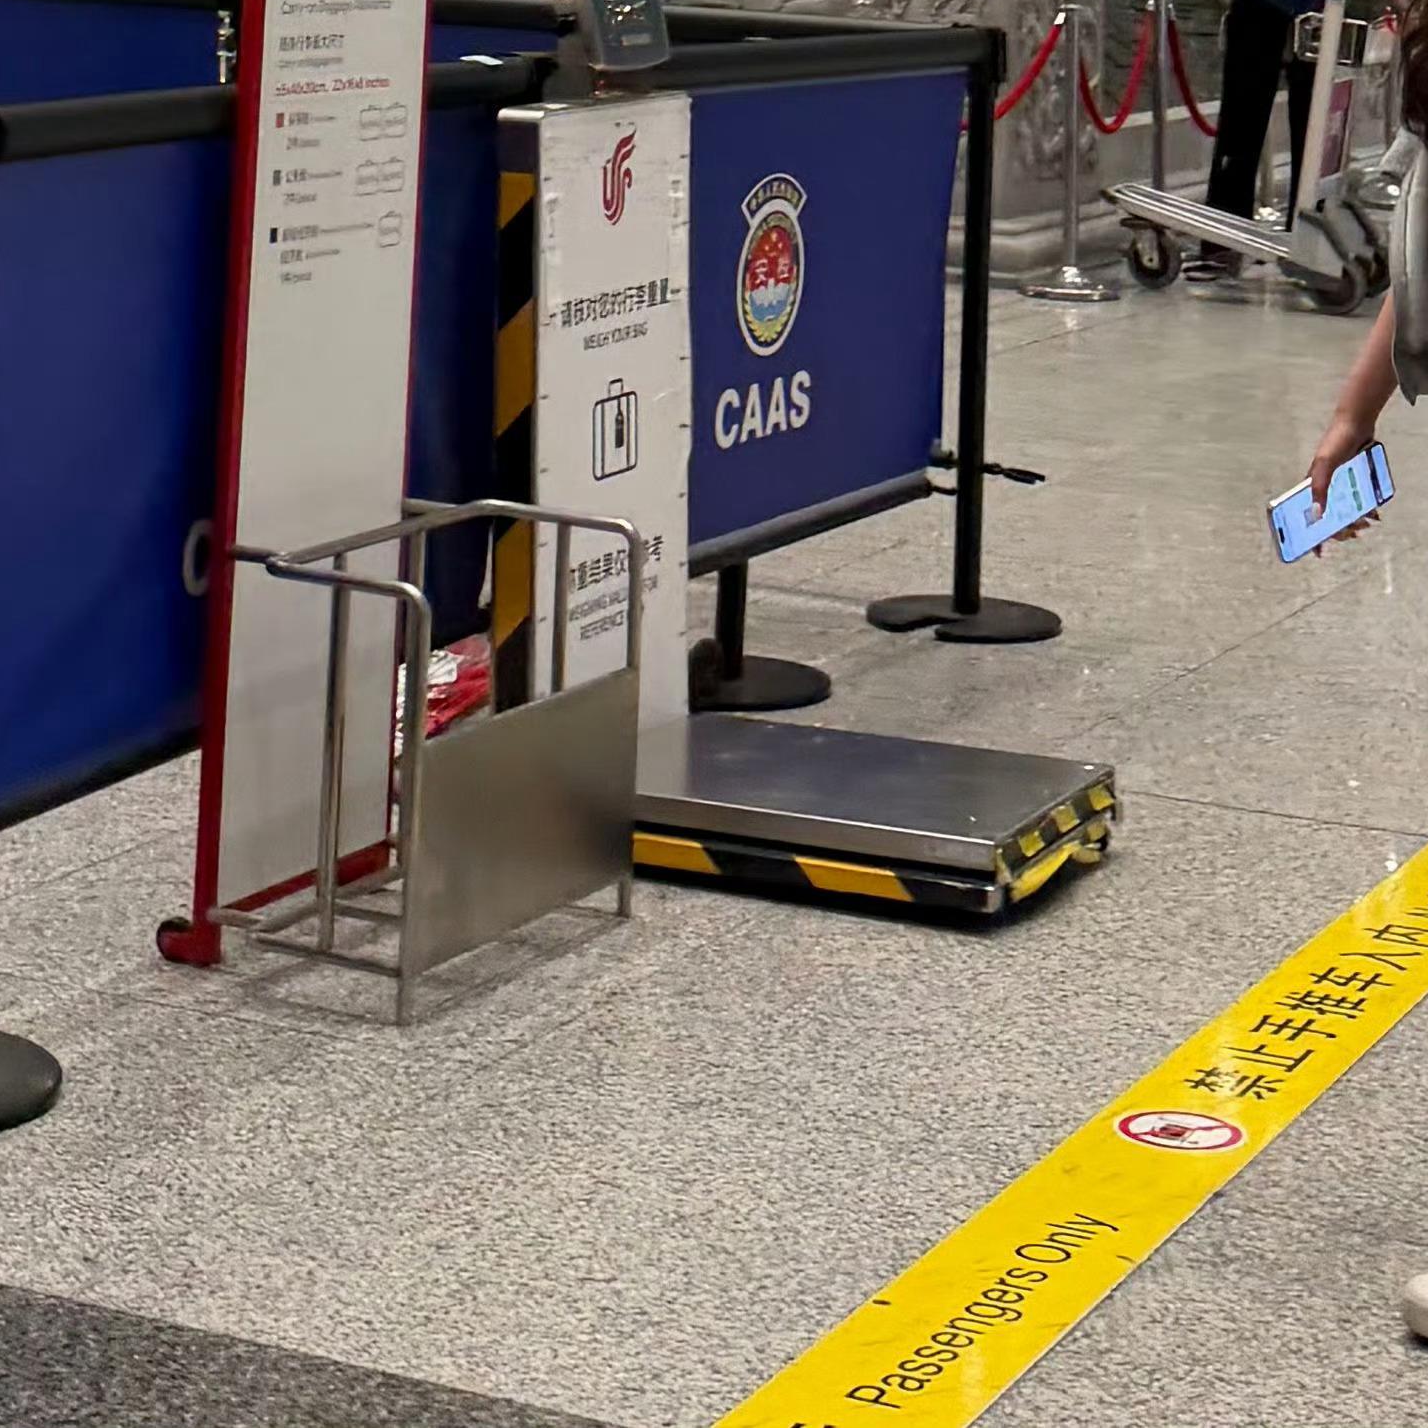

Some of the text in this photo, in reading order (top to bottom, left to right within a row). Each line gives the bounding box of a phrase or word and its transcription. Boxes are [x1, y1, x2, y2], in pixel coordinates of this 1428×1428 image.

[714, 370, 812, 450] CAAS
[844, 1212, 1120, 1411] Passengers Only
